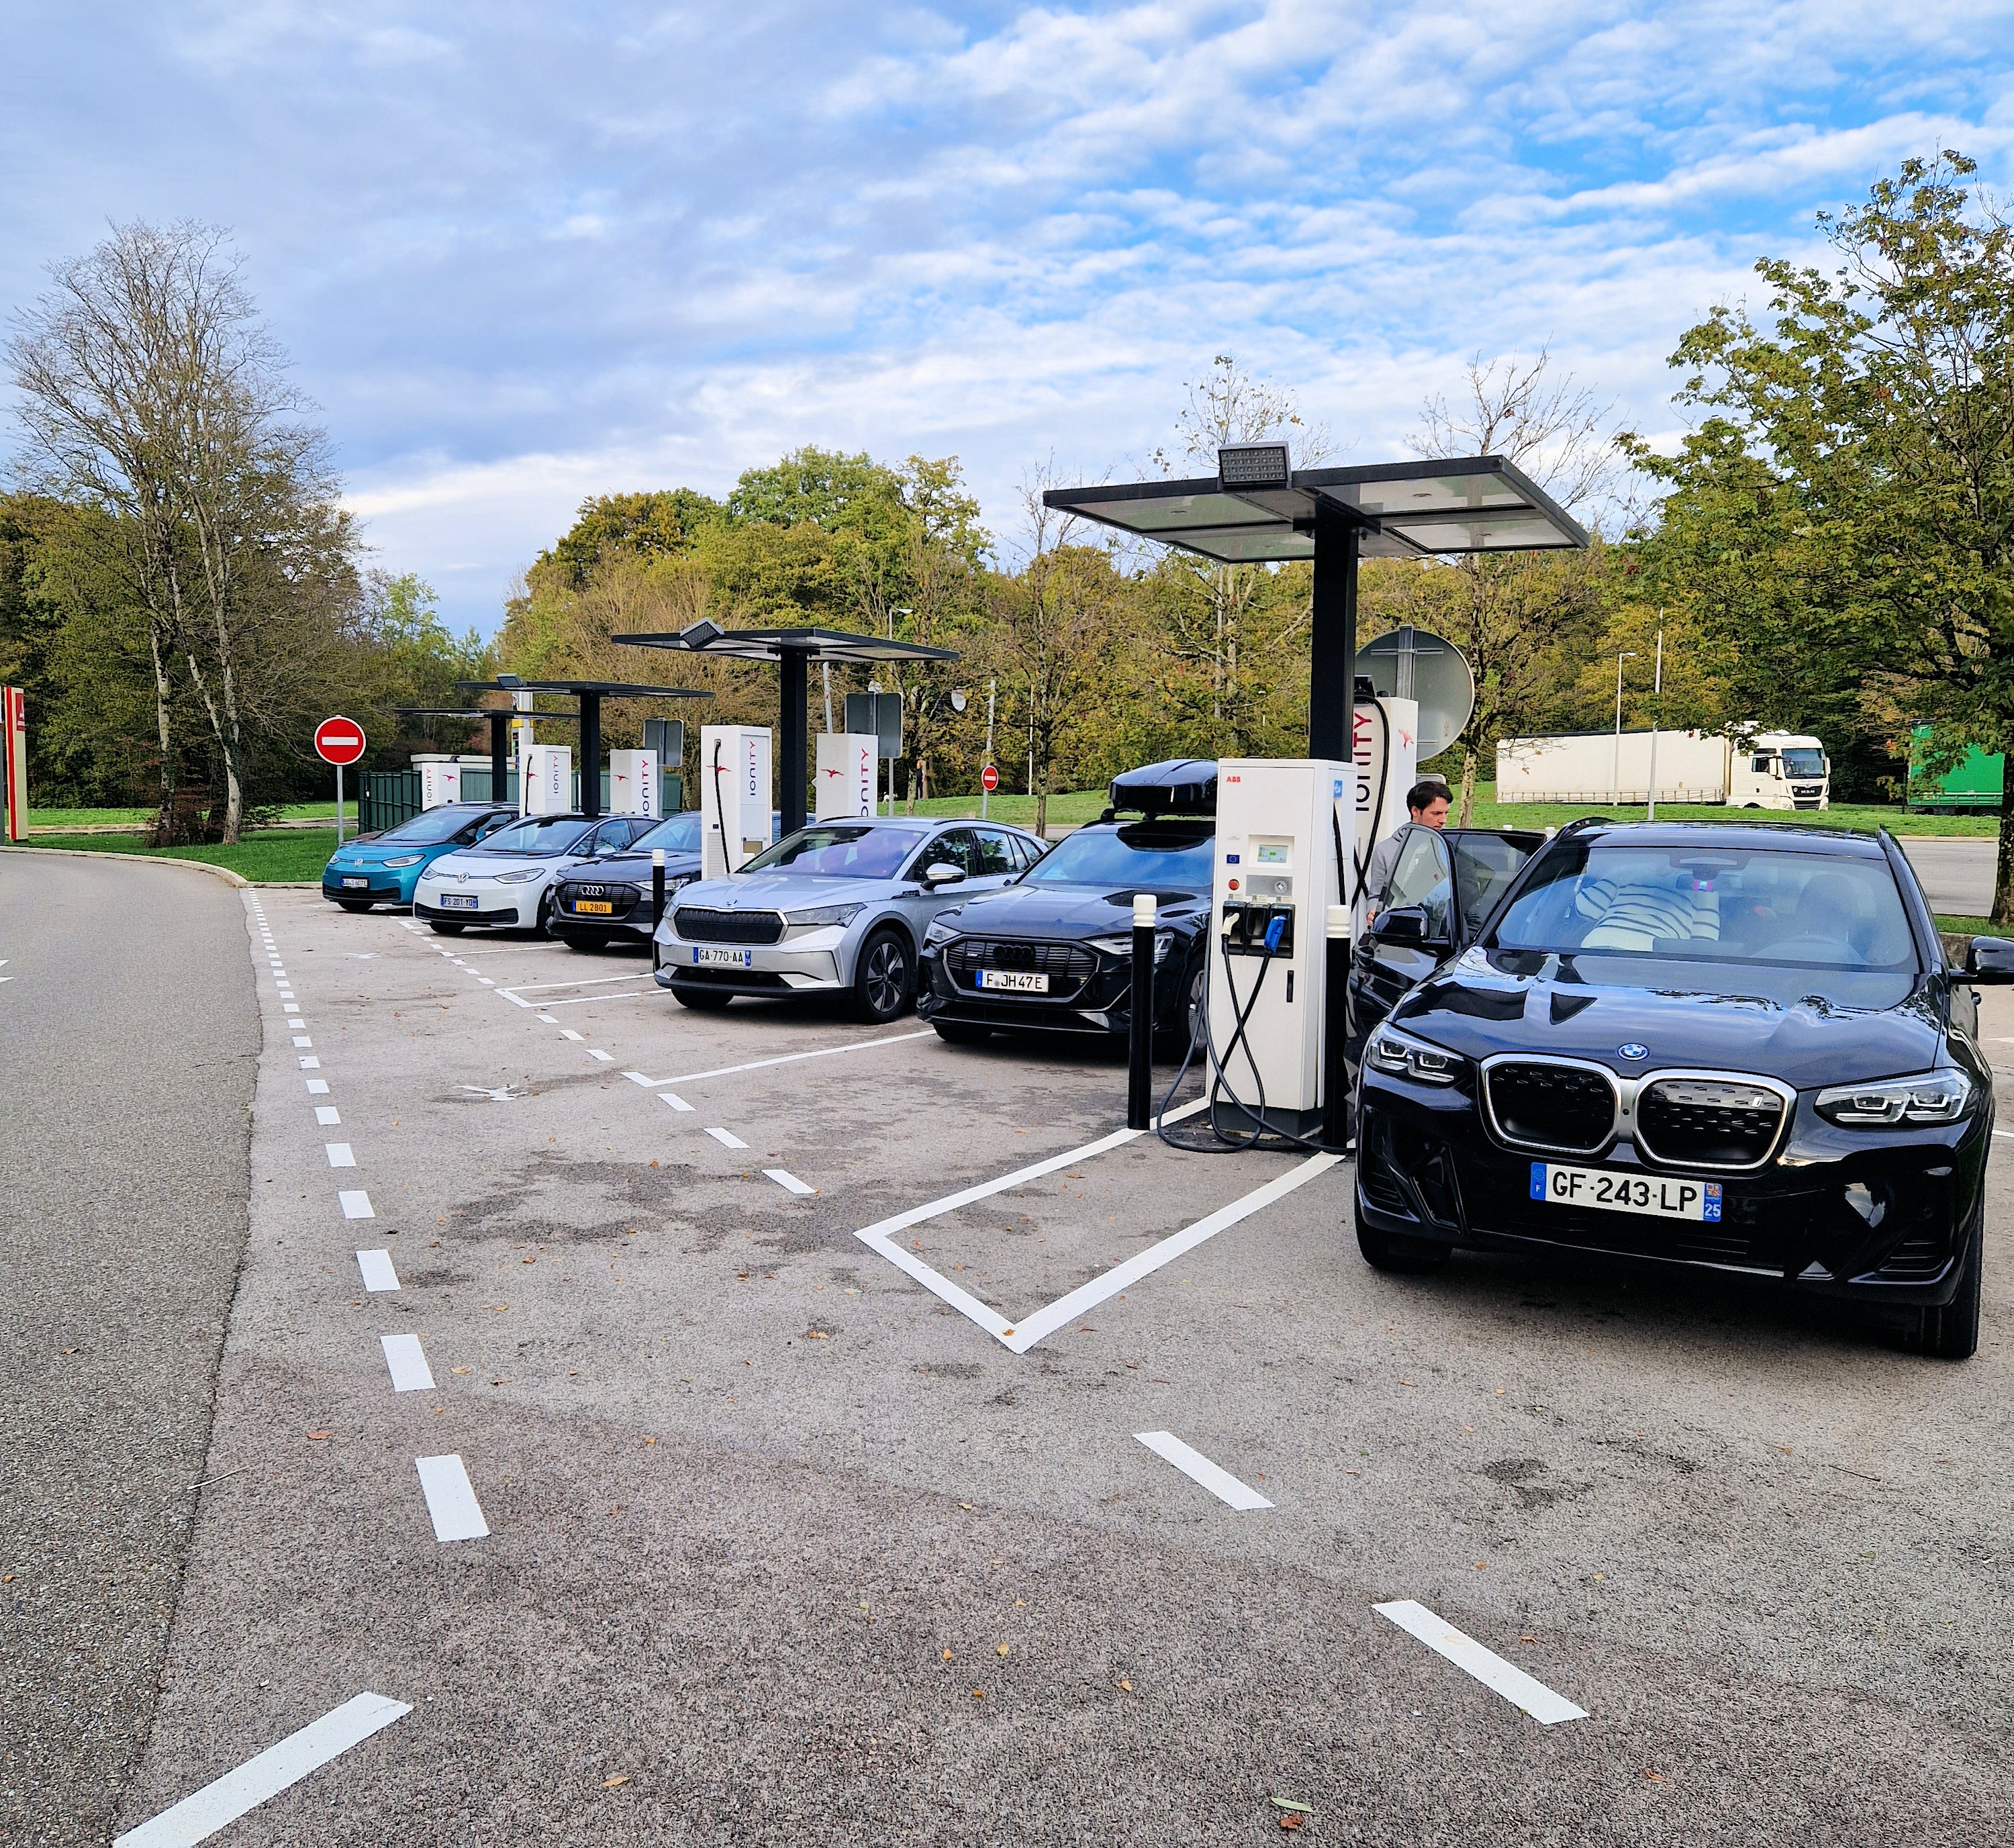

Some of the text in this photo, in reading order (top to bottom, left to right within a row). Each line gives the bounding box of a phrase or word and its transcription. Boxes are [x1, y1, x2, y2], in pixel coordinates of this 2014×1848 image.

[861, 747, 869, 816] ONITY
[699, 949, 743, 963] GA-770-AA
[1552, 1171, 1697, 1212] GF-243-LP
[1705, 1203, 1721, 1217] 25
